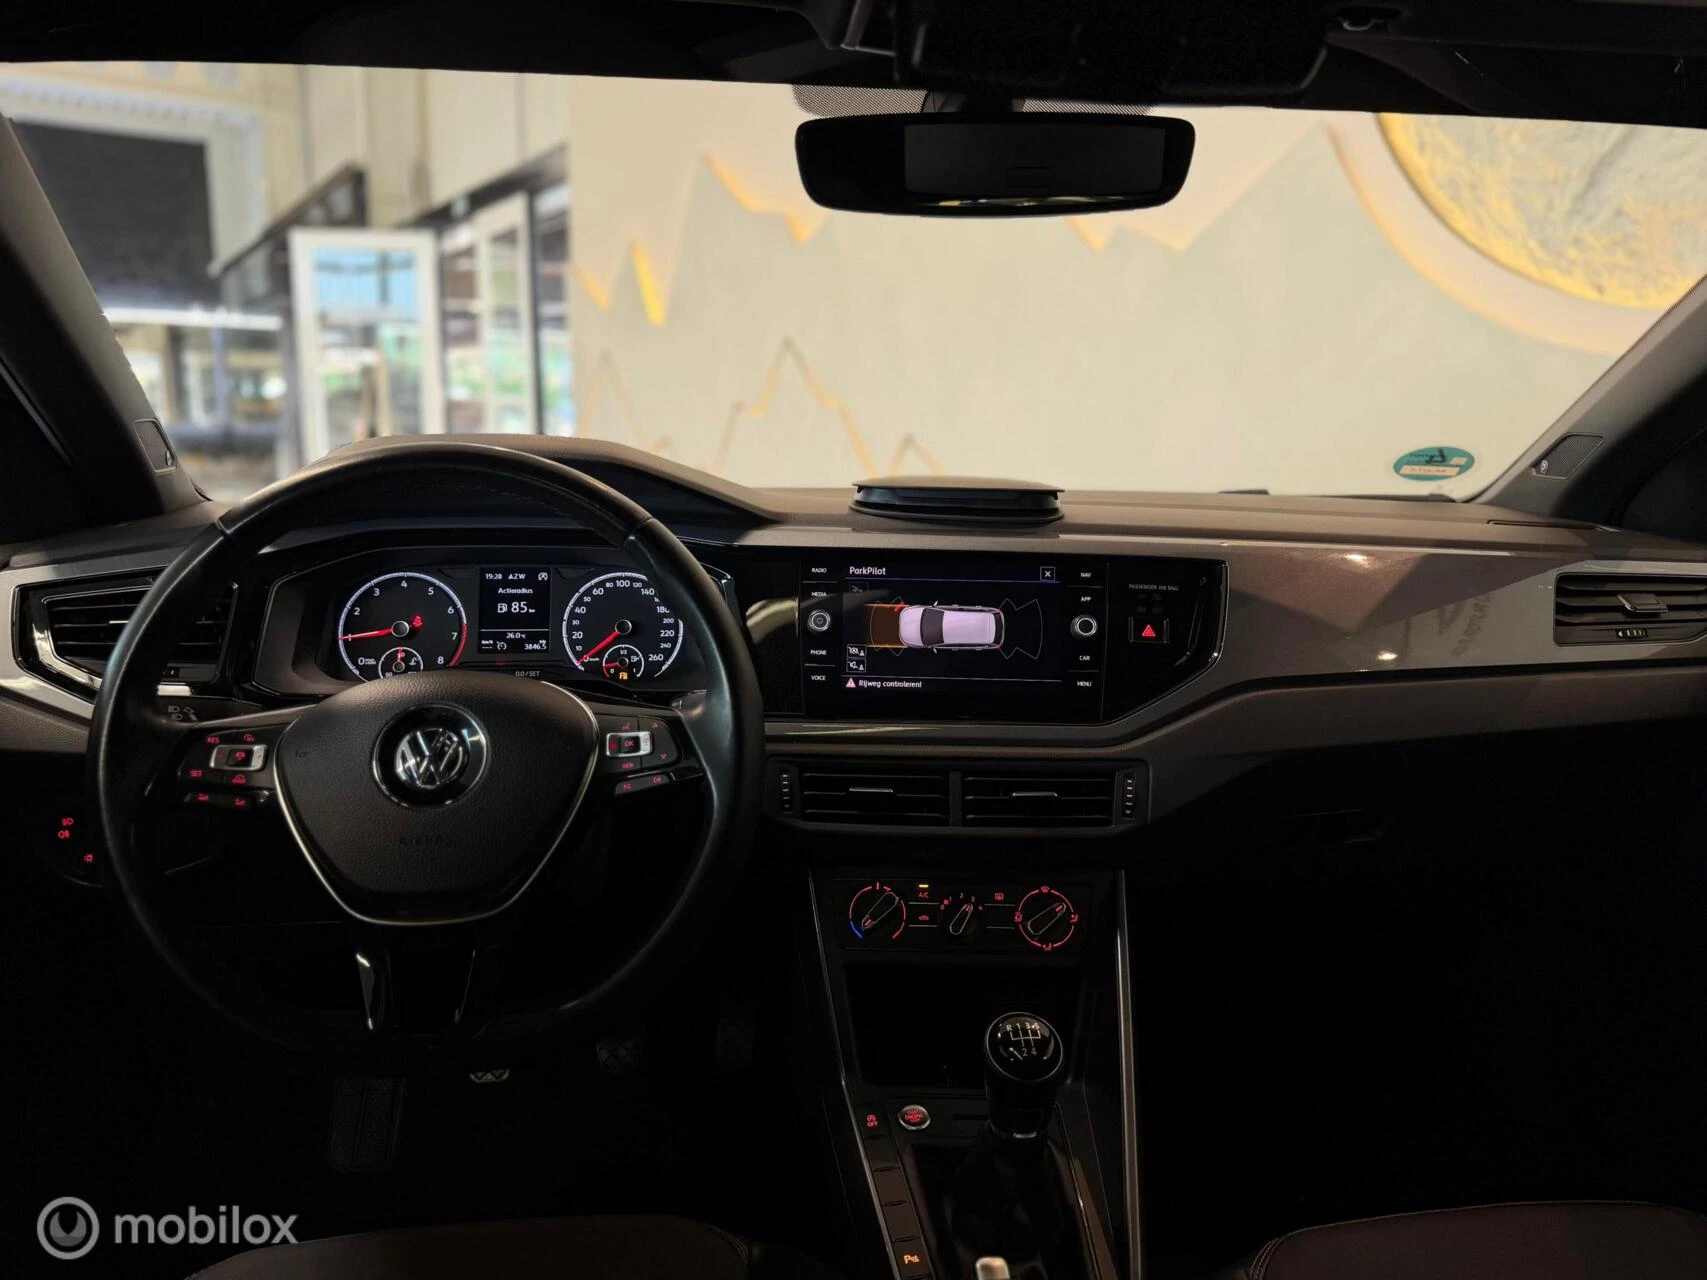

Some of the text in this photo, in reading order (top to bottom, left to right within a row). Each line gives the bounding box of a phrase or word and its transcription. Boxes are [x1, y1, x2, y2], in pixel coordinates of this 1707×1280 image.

[849, 566, 886, 576] ParkPilot
[400, 580, 408, 588] 4
[373, 588, 380, 596] 3
[428, 587, 434, 595] 5
[641, 588, 655, 596] 140
[353, 607, 361, 615] 2
[447, 606, 454, 614] 6
[511, 601, 528, 613] 85
[574, 606, 586, 614] 40
[451, 632, 458, 640] 7
[572, 631, 583, 639] 20
[437, 656, 444, 664] 8
[858, 679, 882, 689] Rijweg
[1021, 1047, 1028, 1056] 2
[1031, 1047, 1038, 1056] 4
